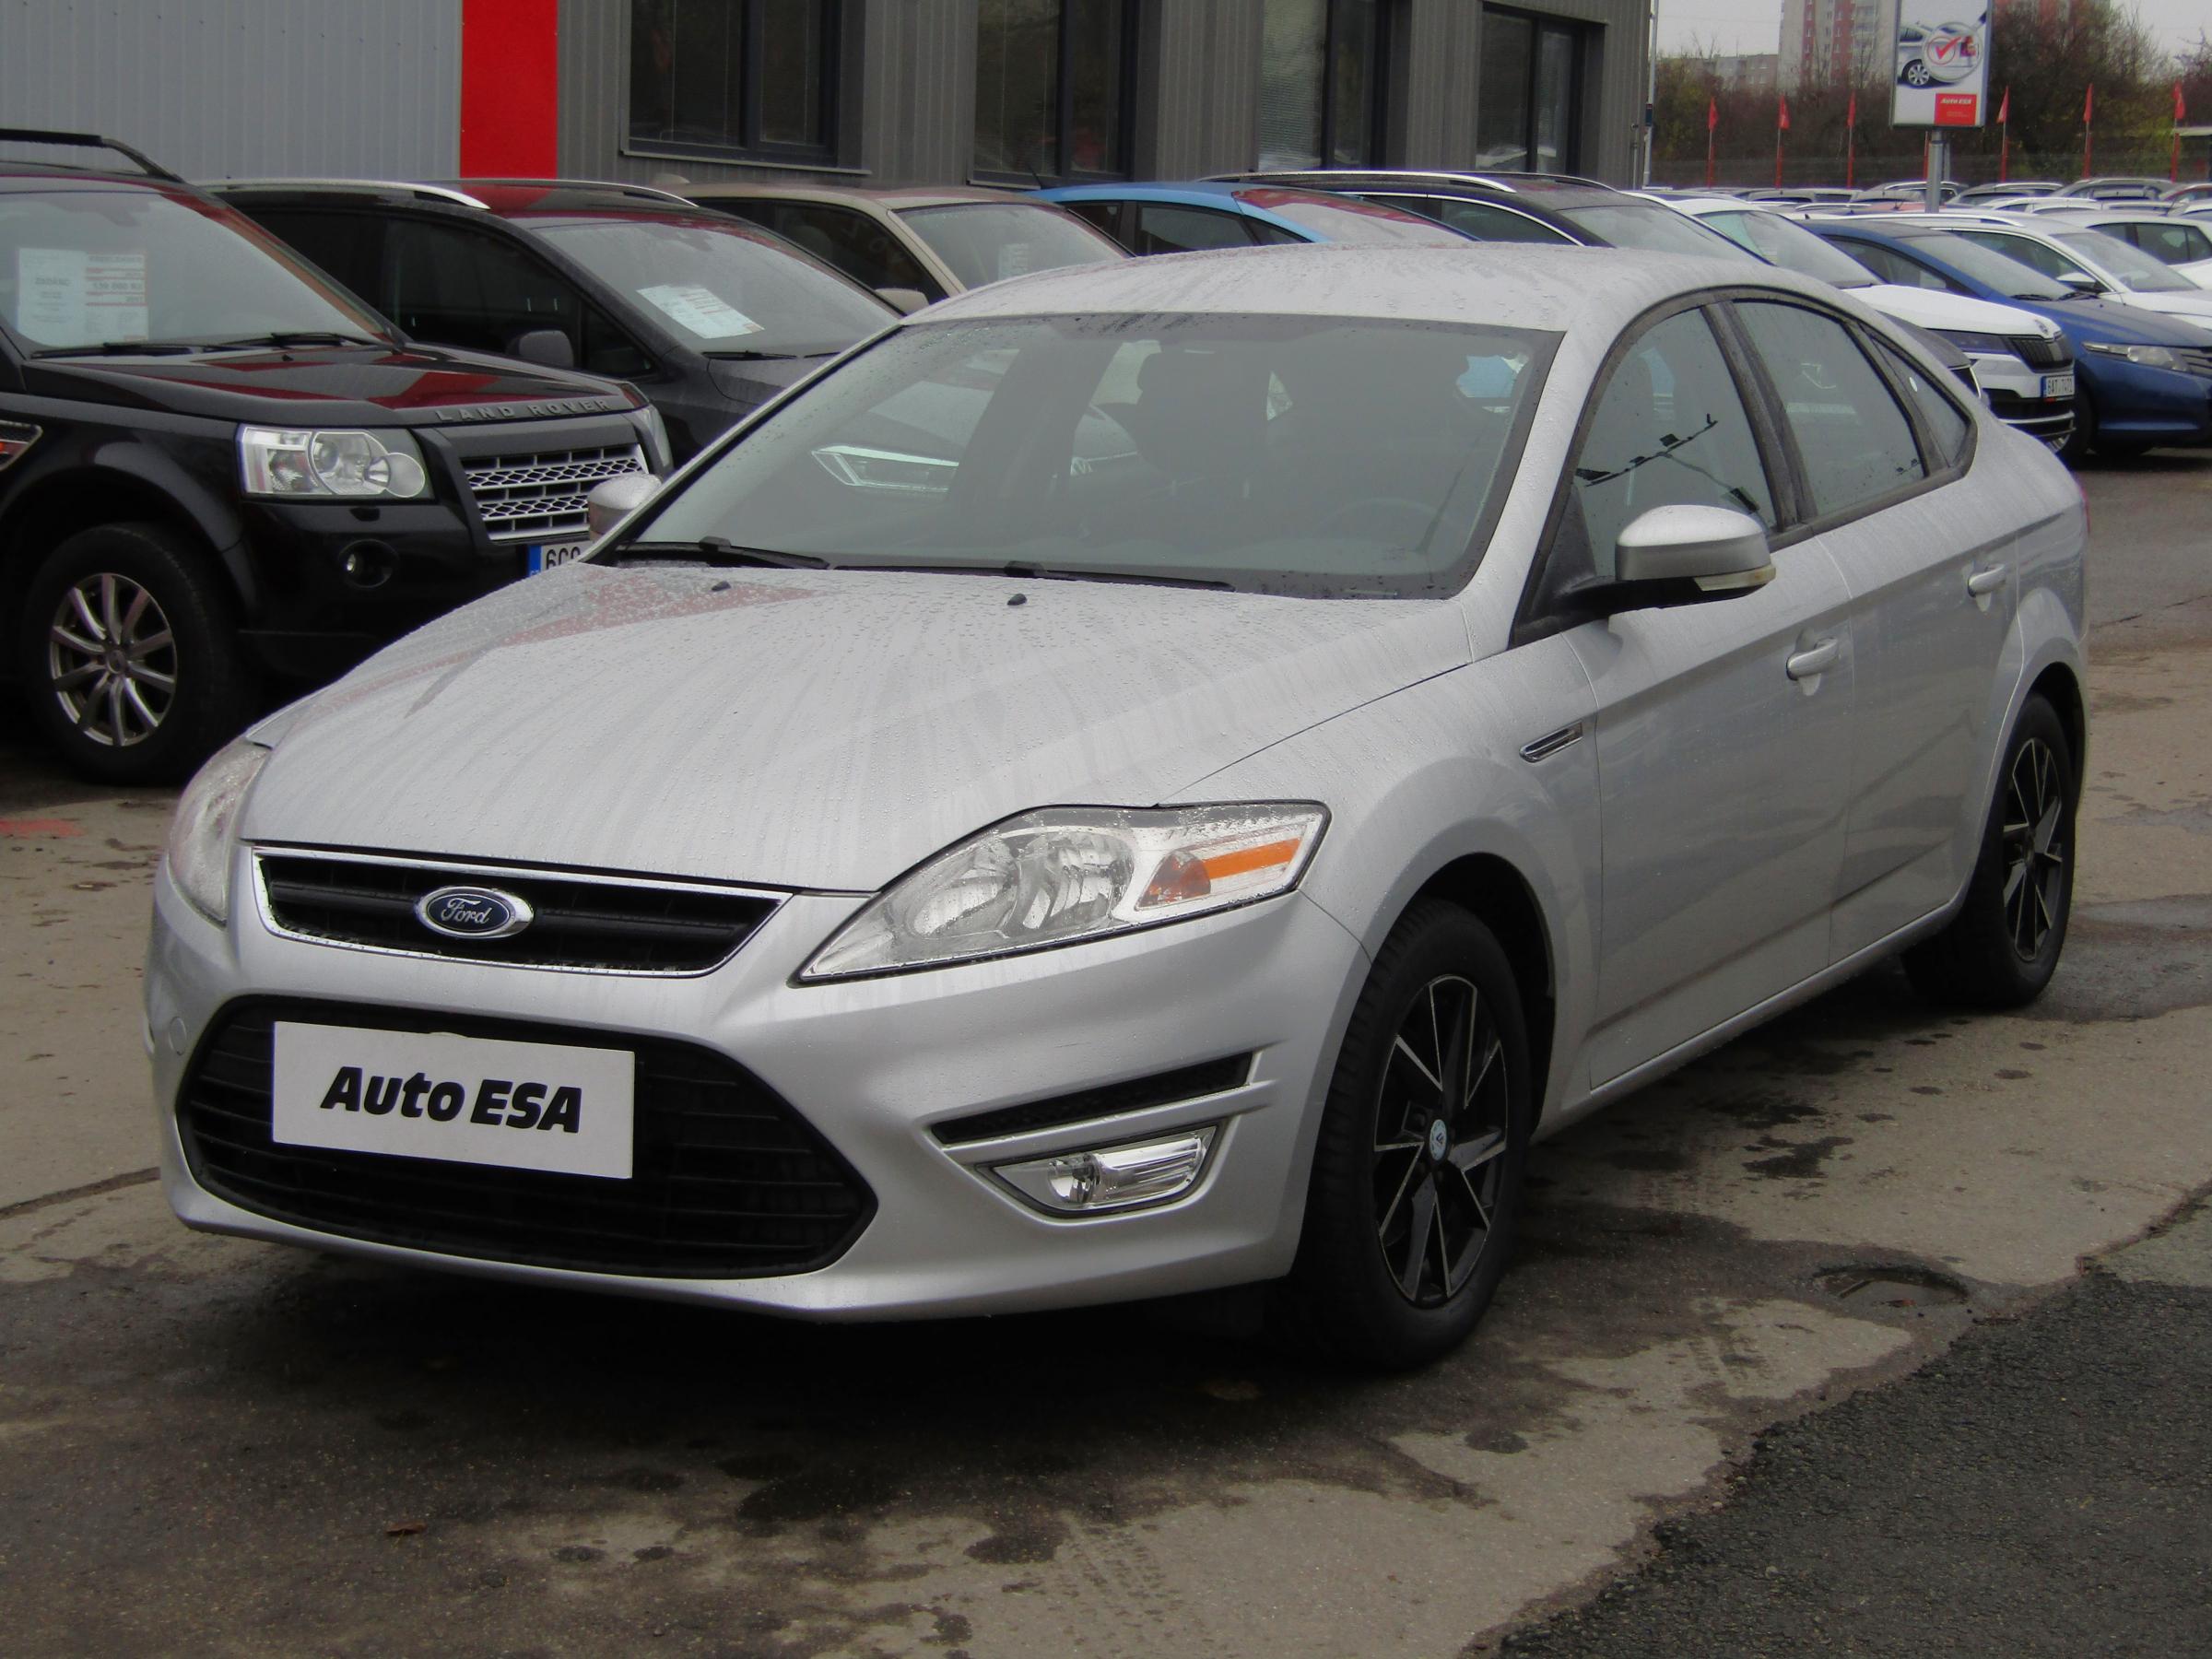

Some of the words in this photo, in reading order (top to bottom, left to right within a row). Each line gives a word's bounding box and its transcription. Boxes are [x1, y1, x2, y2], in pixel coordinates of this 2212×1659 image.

[436, 406, 515, 421] LAND
[526, 399, 611, 415] ROVER
[441, 897, 492, 924] Ford
[320, 1065, 465, 1123] Auto
[470, 1078, 582, 1134] ESA
